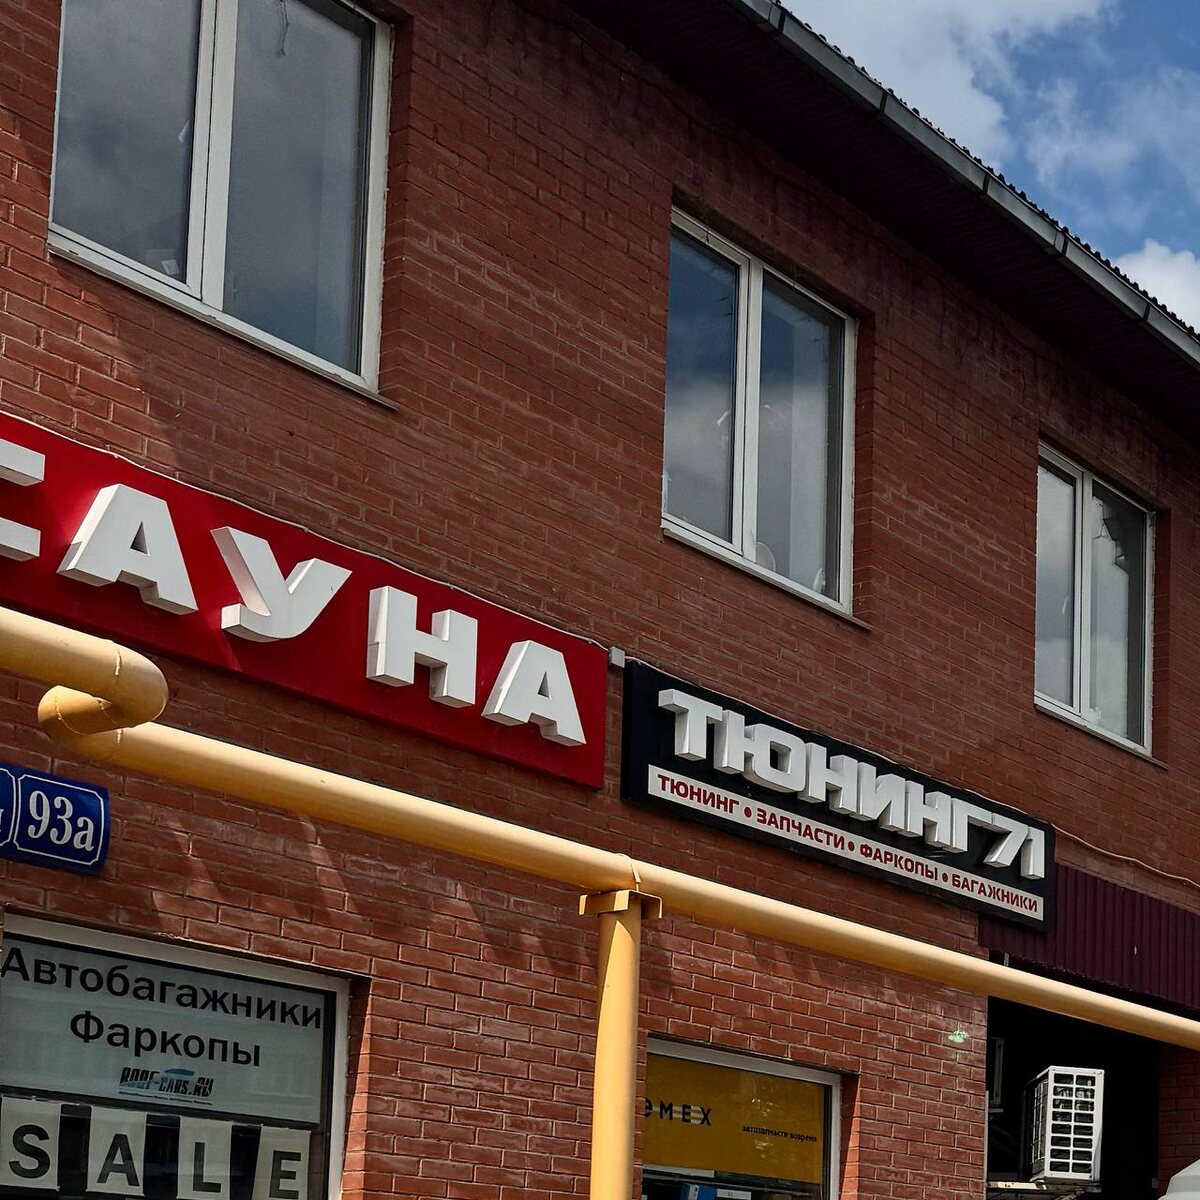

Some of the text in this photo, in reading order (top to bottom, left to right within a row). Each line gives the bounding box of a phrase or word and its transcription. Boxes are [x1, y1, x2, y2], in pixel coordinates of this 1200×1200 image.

[27, 790, 95, 852] 93а
[658, 688, 1046, 880] ТЮНИНГ71
[657, 773, 1038, 914] ТЮНИНГ ЗАПЧАСТИ ФАРКОПЫ БАГАЖНИКИ
[1, 946, 322, 1030] Автобагажники
[69, 1010, 261, 1068] Фаркопы
[8, 1123, 303, 1200] SALE
